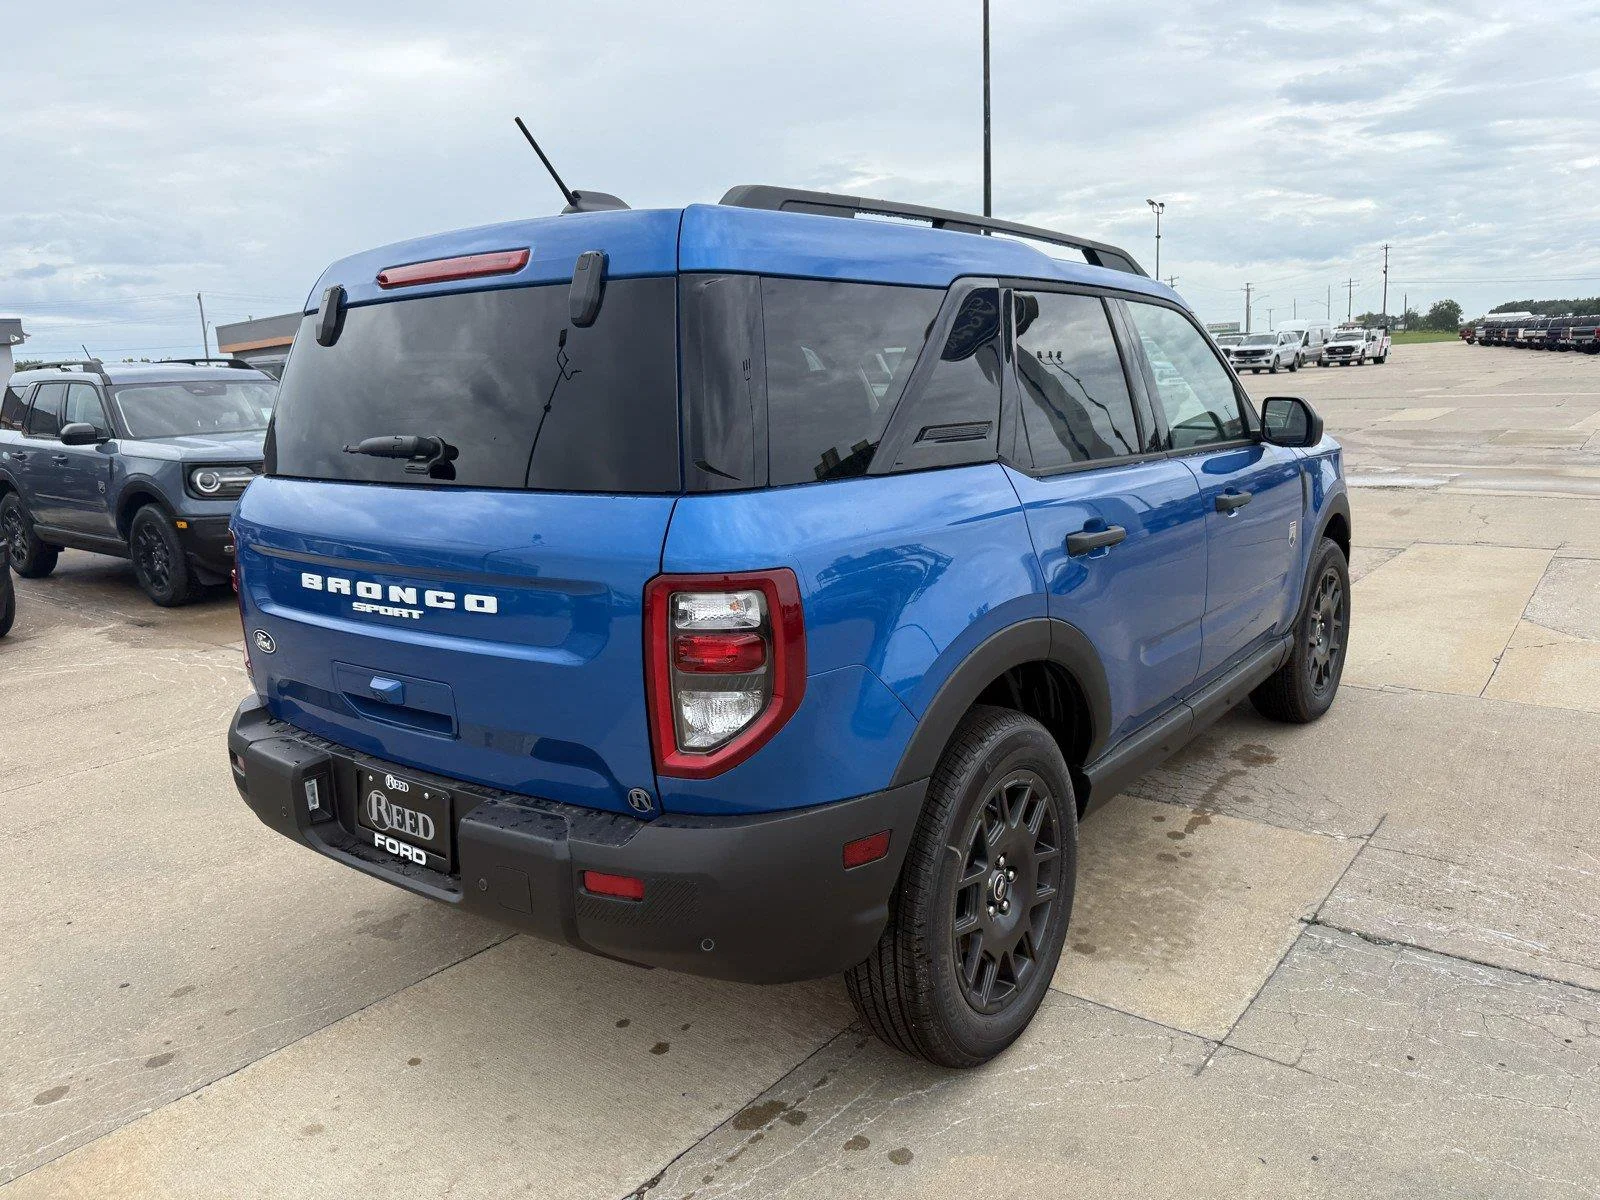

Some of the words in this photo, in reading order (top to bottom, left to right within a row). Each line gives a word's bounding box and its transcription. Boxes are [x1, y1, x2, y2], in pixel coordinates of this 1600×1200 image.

[301, 572, 498, 614] BRONCO
[352, 601, 424, 619] SPORT
[255, 631, 273, 651] Ford
[374, 833, 427, 865] FORD
